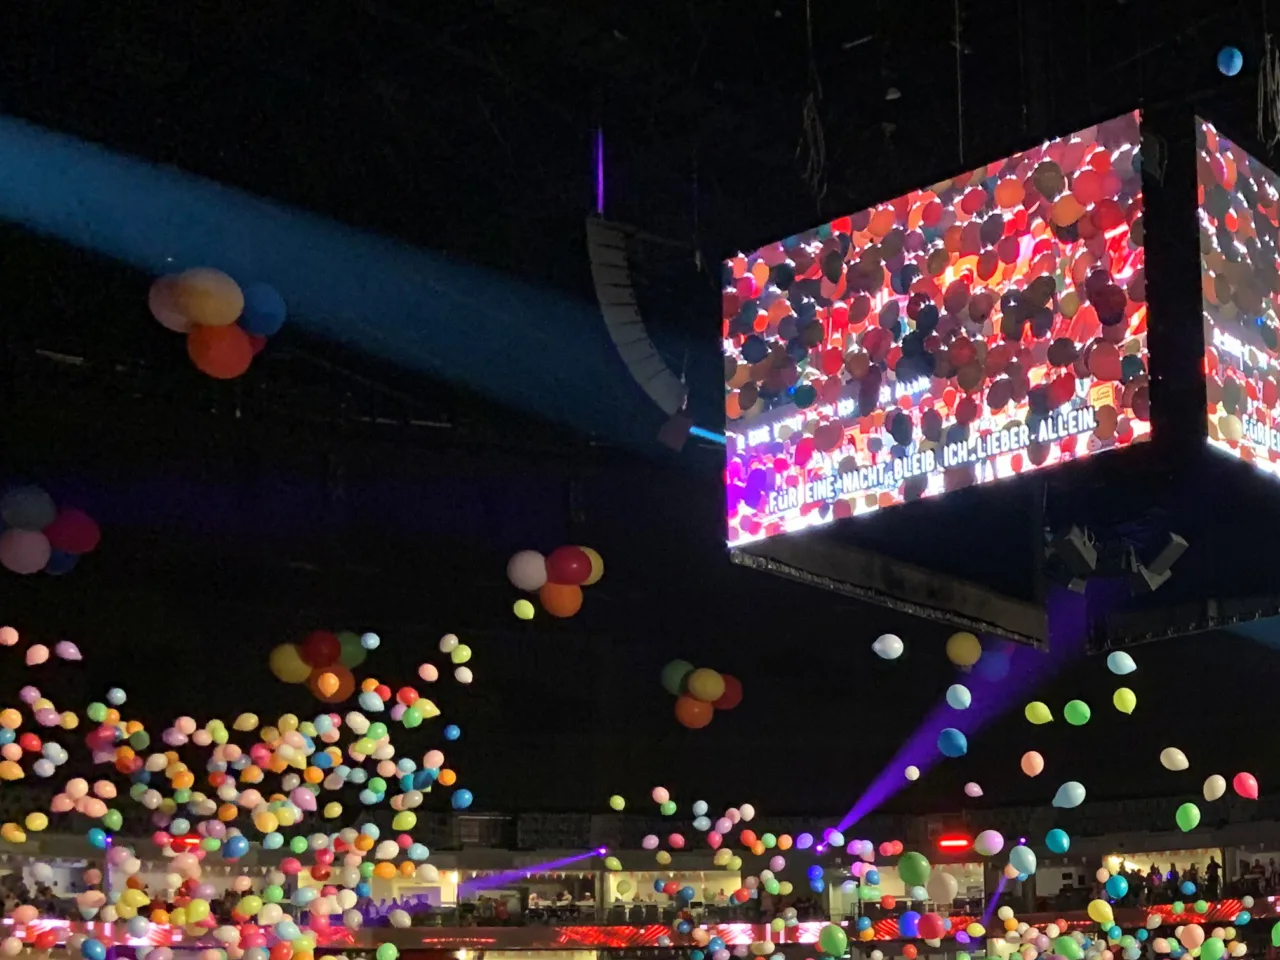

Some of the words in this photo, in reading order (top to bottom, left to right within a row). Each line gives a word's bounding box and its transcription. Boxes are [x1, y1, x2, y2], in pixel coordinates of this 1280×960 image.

[806, 475, 836, 503] EINE
[842, 463, 886, 494] NACHT
[893, 449, 936, 480] BLEIB
[943, 440, 968, 467] ICH
[976, 424, 1030, 458] LIEBER
